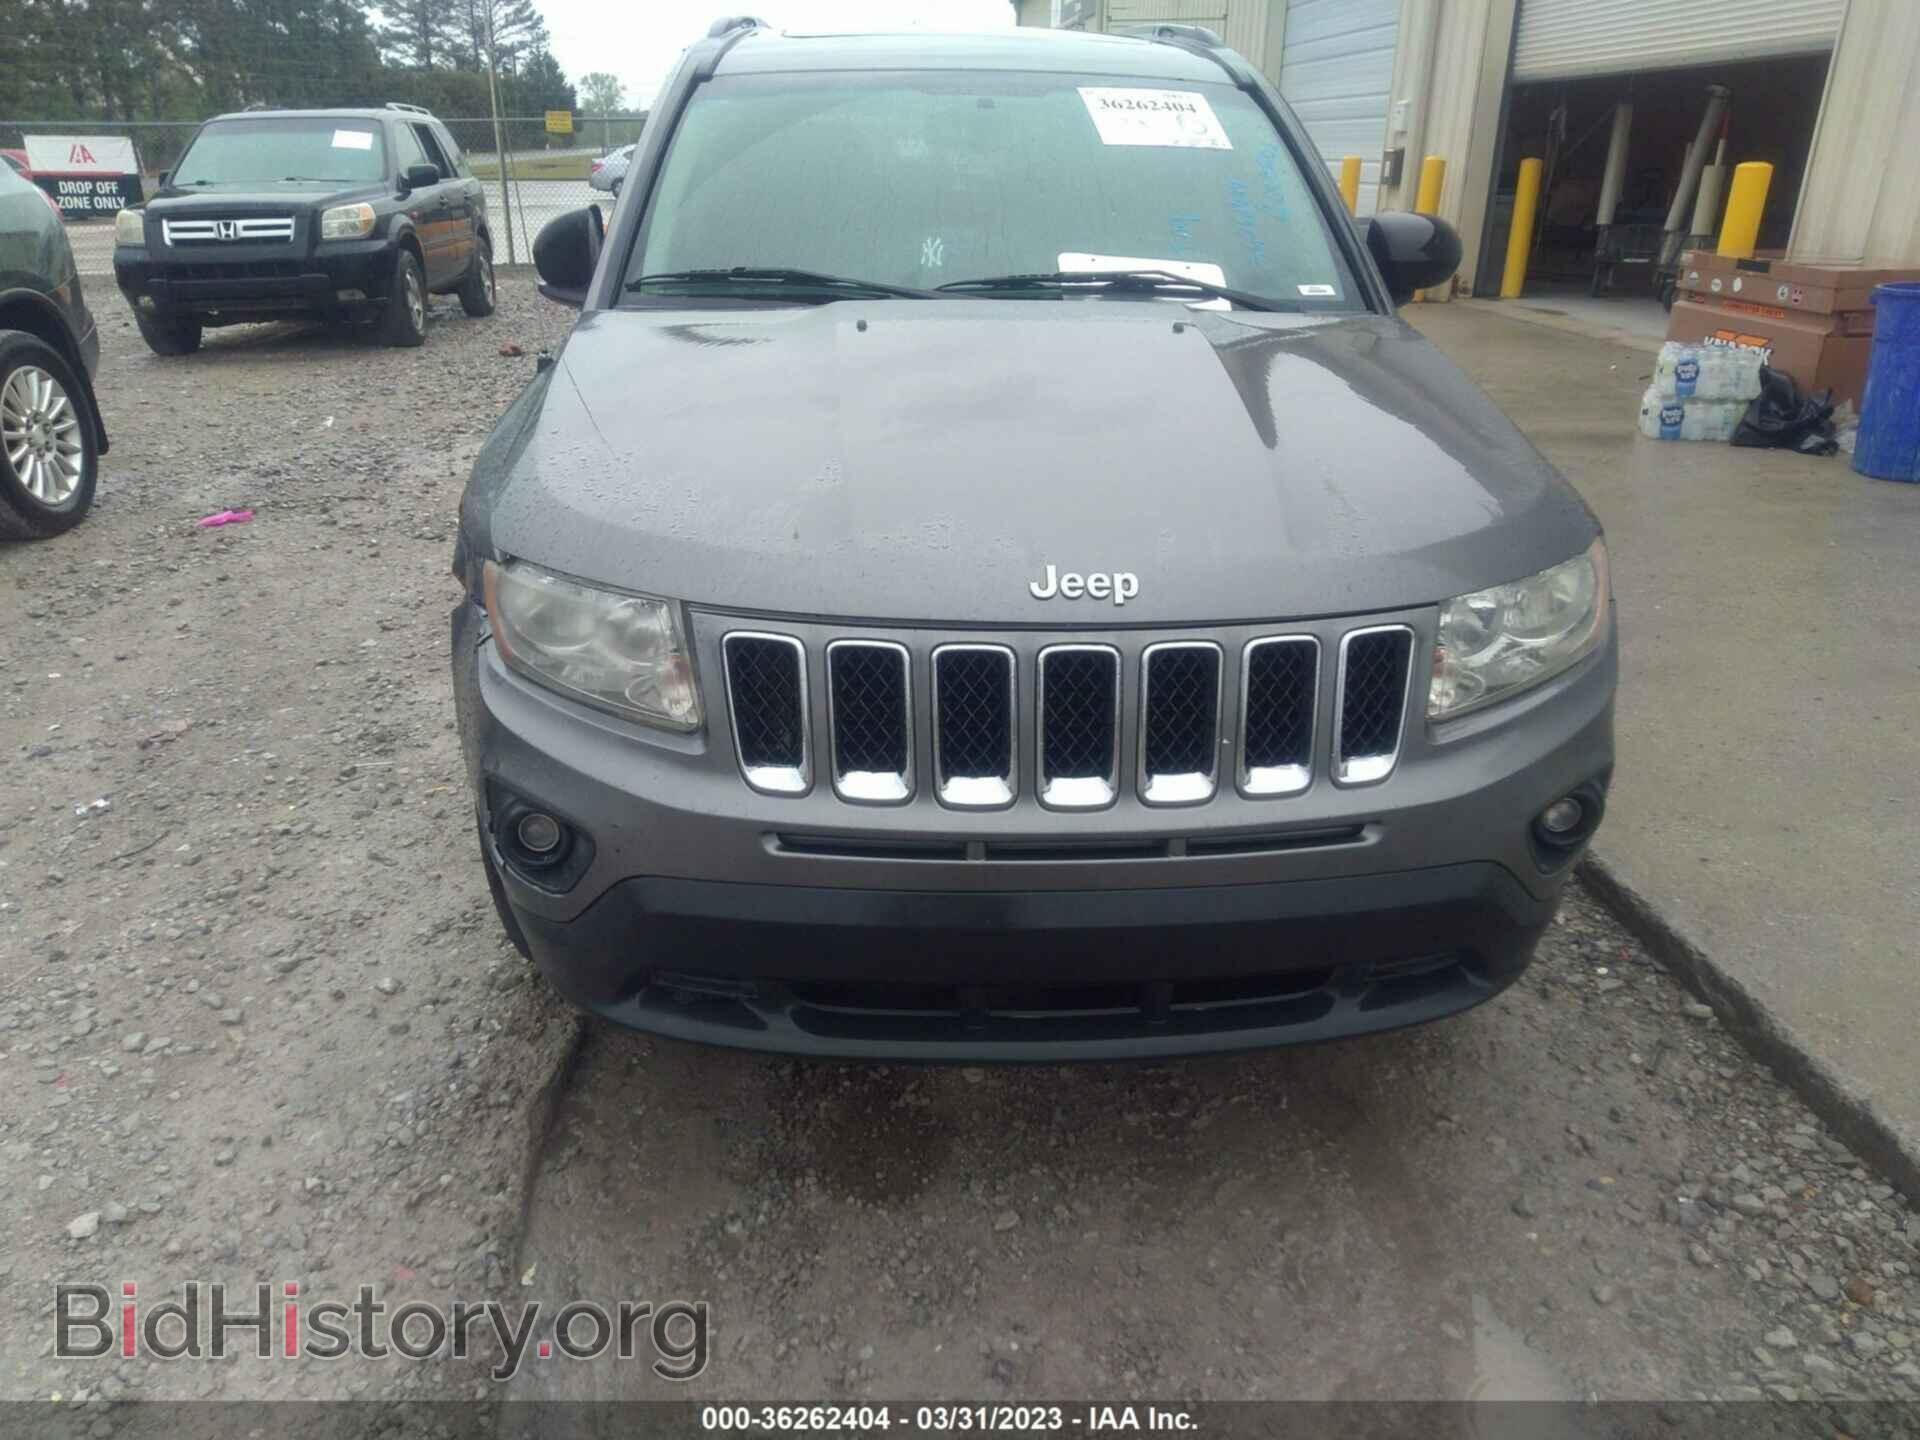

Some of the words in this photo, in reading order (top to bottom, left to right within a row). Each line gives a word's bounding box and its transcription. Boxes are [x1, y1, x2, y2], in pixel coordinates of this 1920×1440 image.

[1099, 98, 1197, 113] 36262404
[58, 181, 93, 195] DROP
[96, 181, 119, 195] OFF
[57, 196, 92, 209] ZONE
[94, 196, 126, 209] ONLY
[1030, 564, 1139, 606] Jeep
